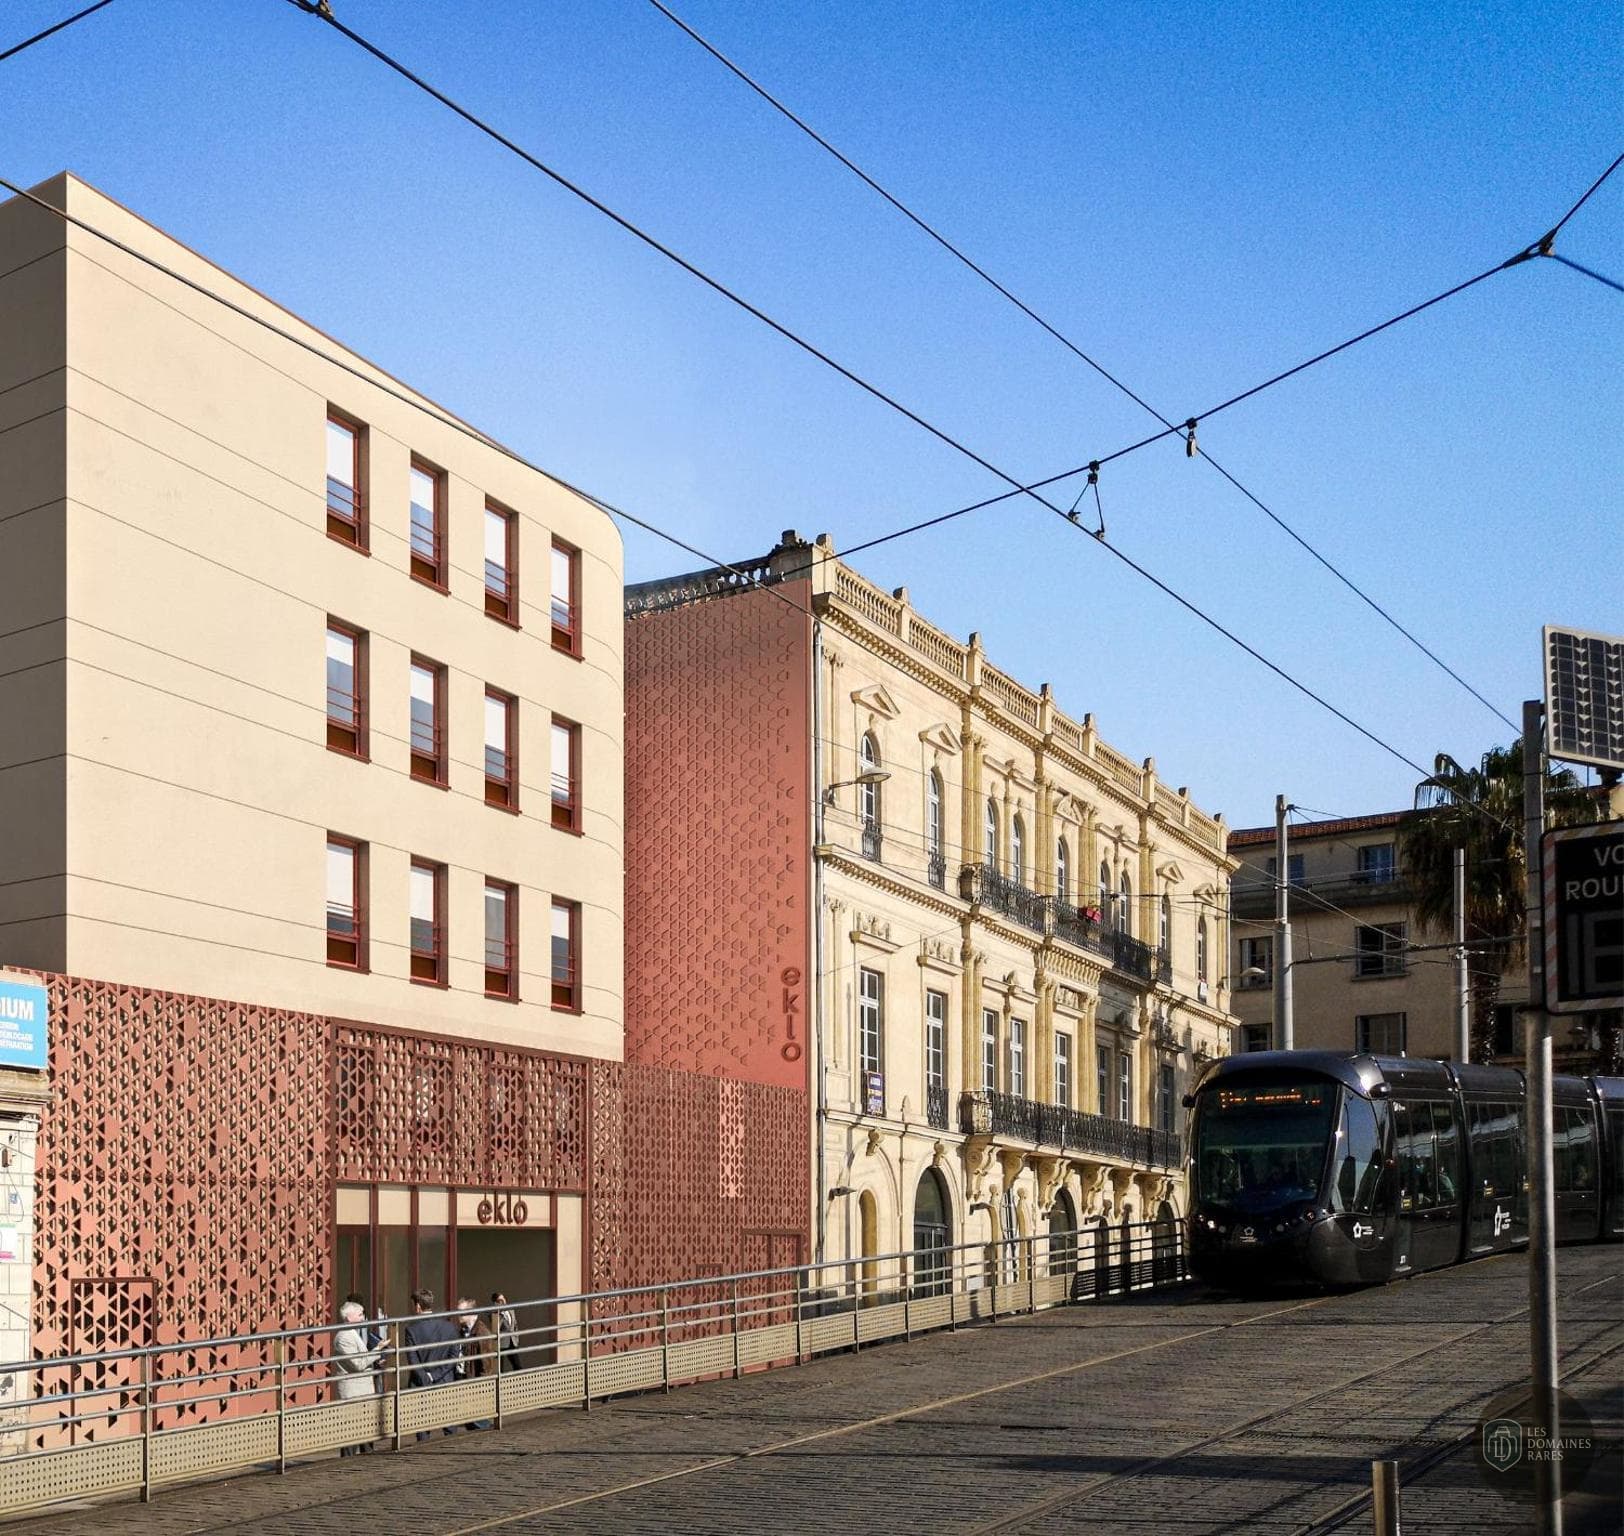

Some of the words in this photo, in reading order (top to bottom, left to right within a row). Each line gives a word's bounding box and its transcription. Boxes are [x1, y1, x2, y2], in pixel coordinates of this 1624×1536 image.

[1566, 874, 1624, 900] ROU
[0, 997, 34, 1020] IUM
[781, 967, 801, 1062] eklo
[477, 1189, 528, 1225] eklo
